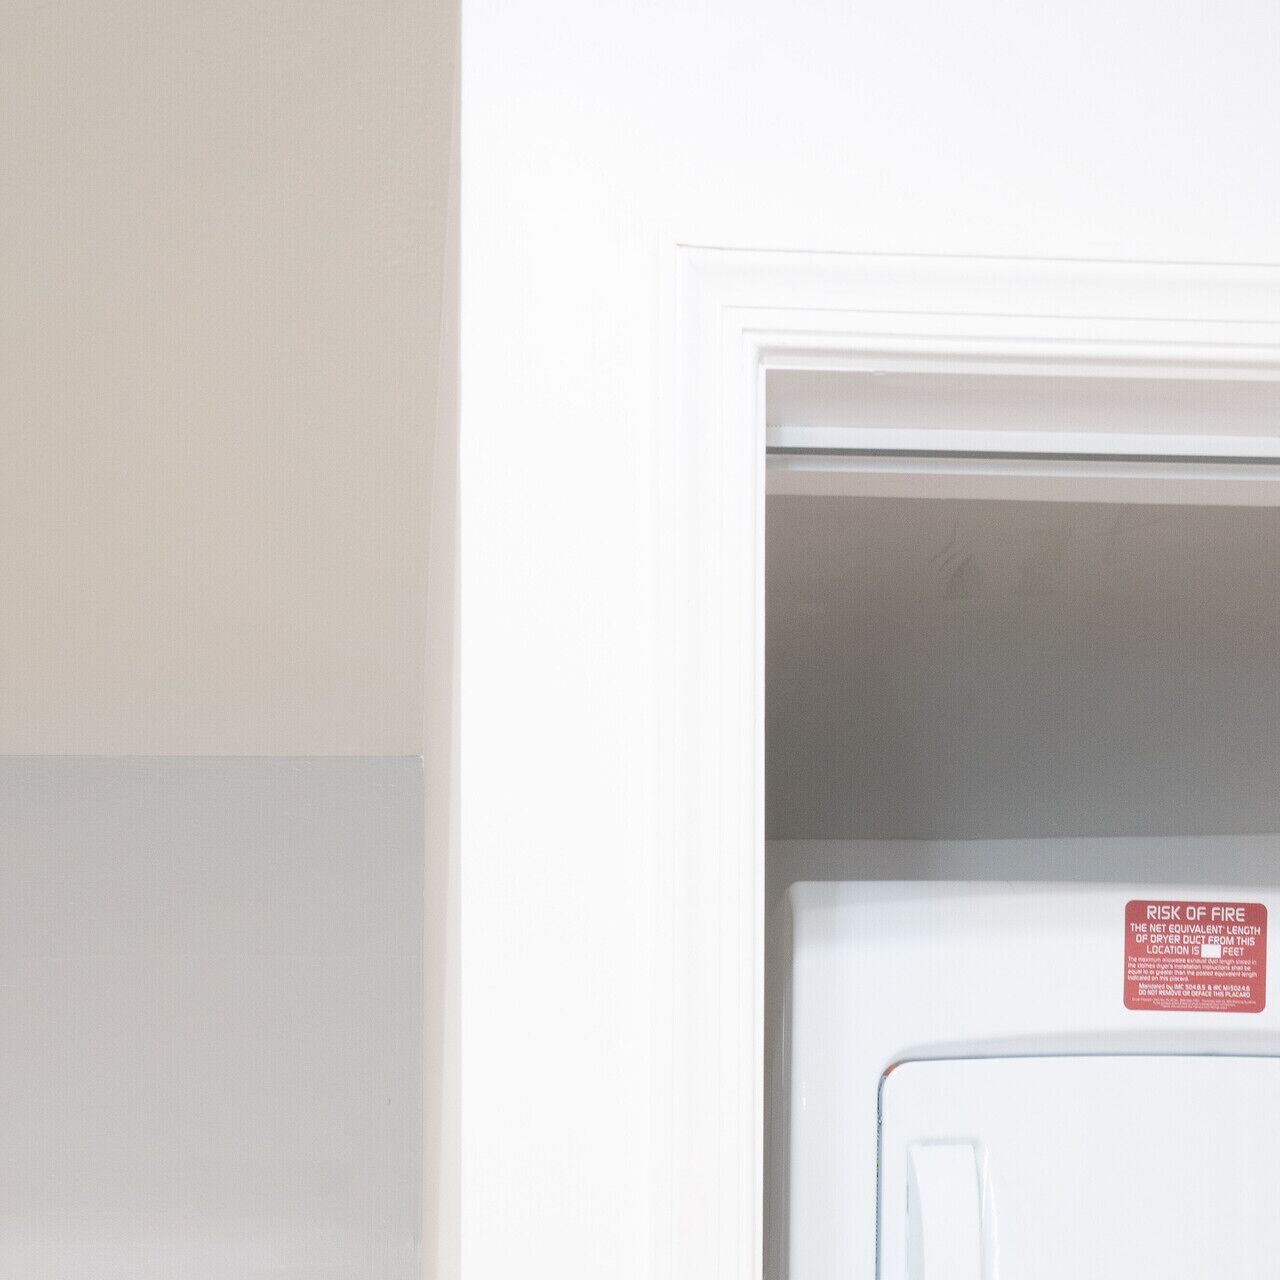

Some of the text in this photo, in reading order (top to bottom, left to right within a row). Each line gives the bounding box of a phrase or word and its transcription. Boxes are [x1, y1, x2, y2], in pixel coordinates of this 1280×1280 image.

[1146, 905, 1245, 922] RISK OF FIRE
[1130, 923, 1261, 935] THE NET EQUIVALENT LENGTH
[1135, 934, 1255, 946] OF DRYER DUCT FROM THIS
[1146, 945, 1244, 956] LOCATION IS FEET
